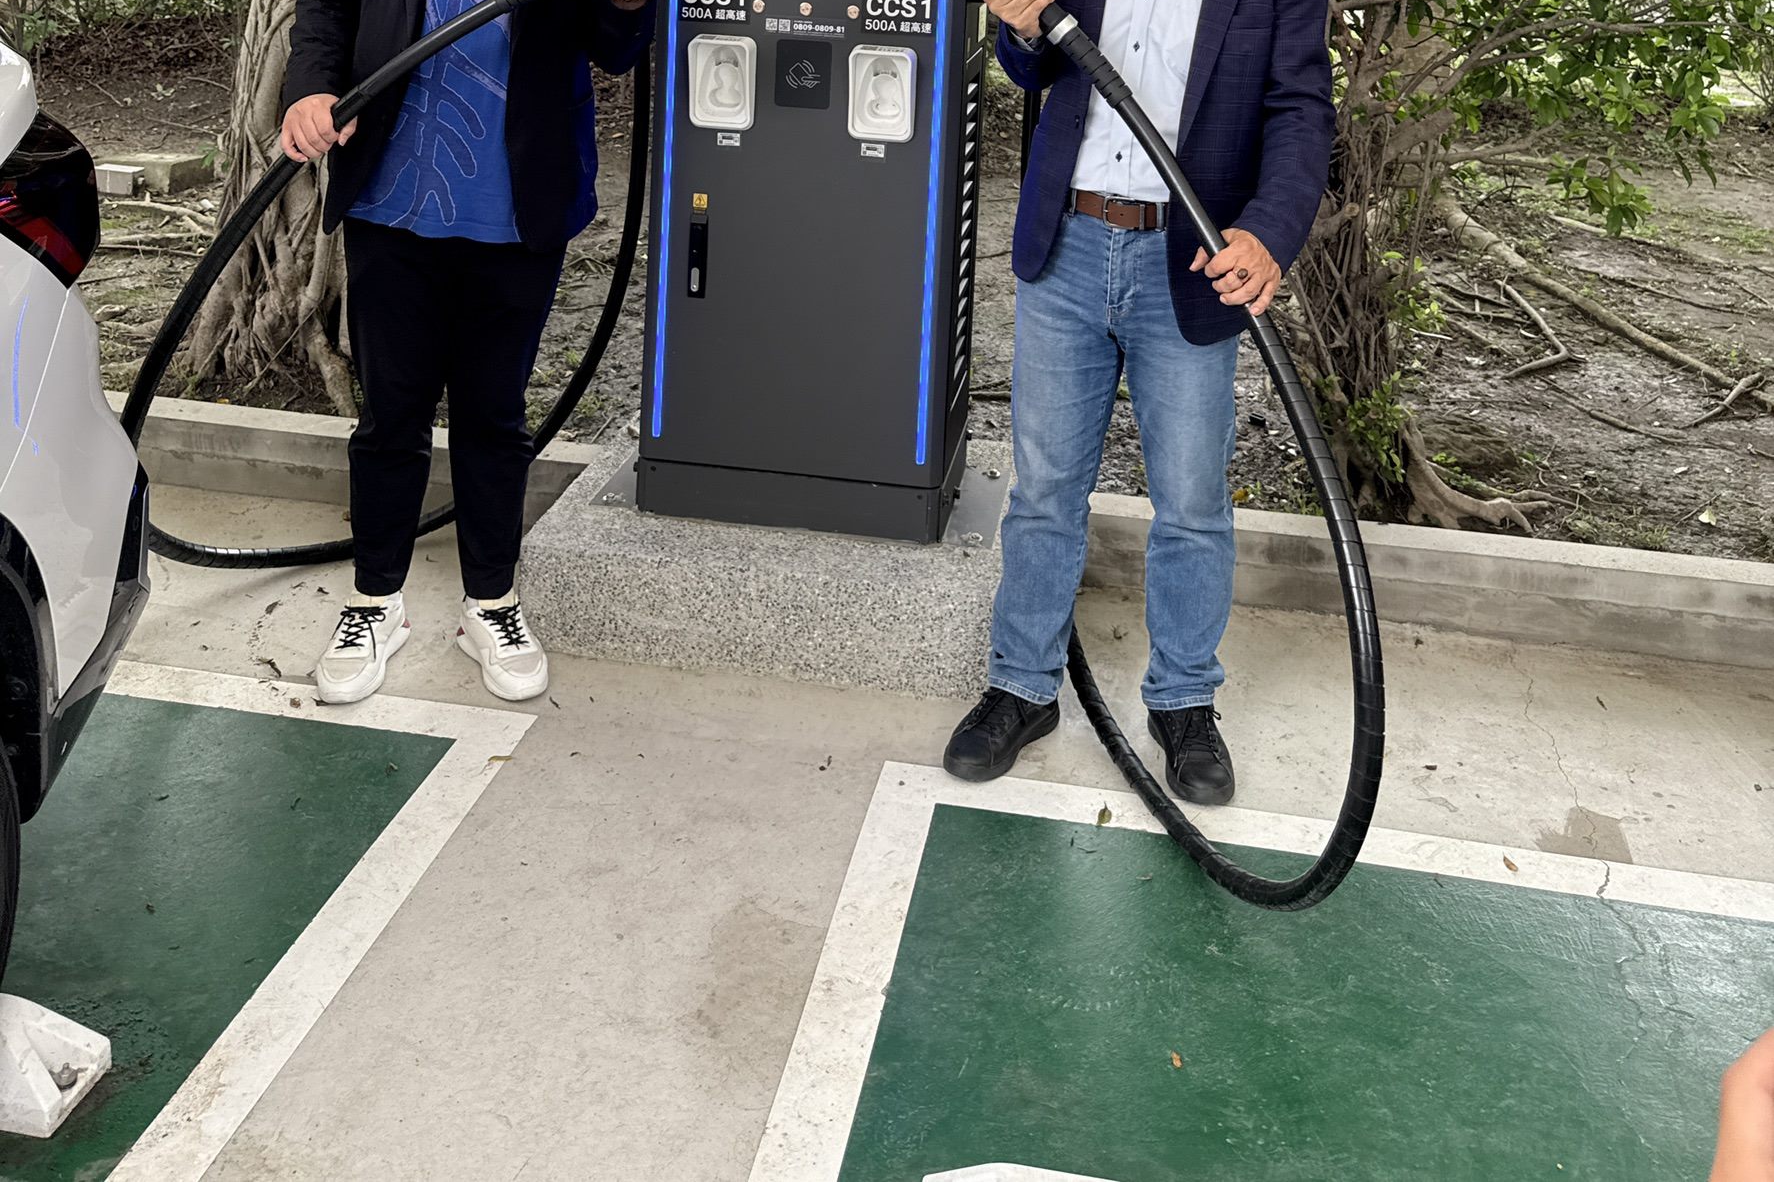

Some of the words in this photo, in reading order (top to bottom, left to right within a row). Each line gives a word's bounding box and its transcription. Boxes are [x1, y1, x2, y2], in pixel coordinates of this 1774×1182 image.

[681, 7, 713, 19] 500A
[715, 8, 746, 21] 超高速
[921, 0, 931, 19] 1
[793, 23, 845, 33] 0809-0809-81
[865, 19, 897, 32] 500A
[900, 21, 932, 34] 超高速
